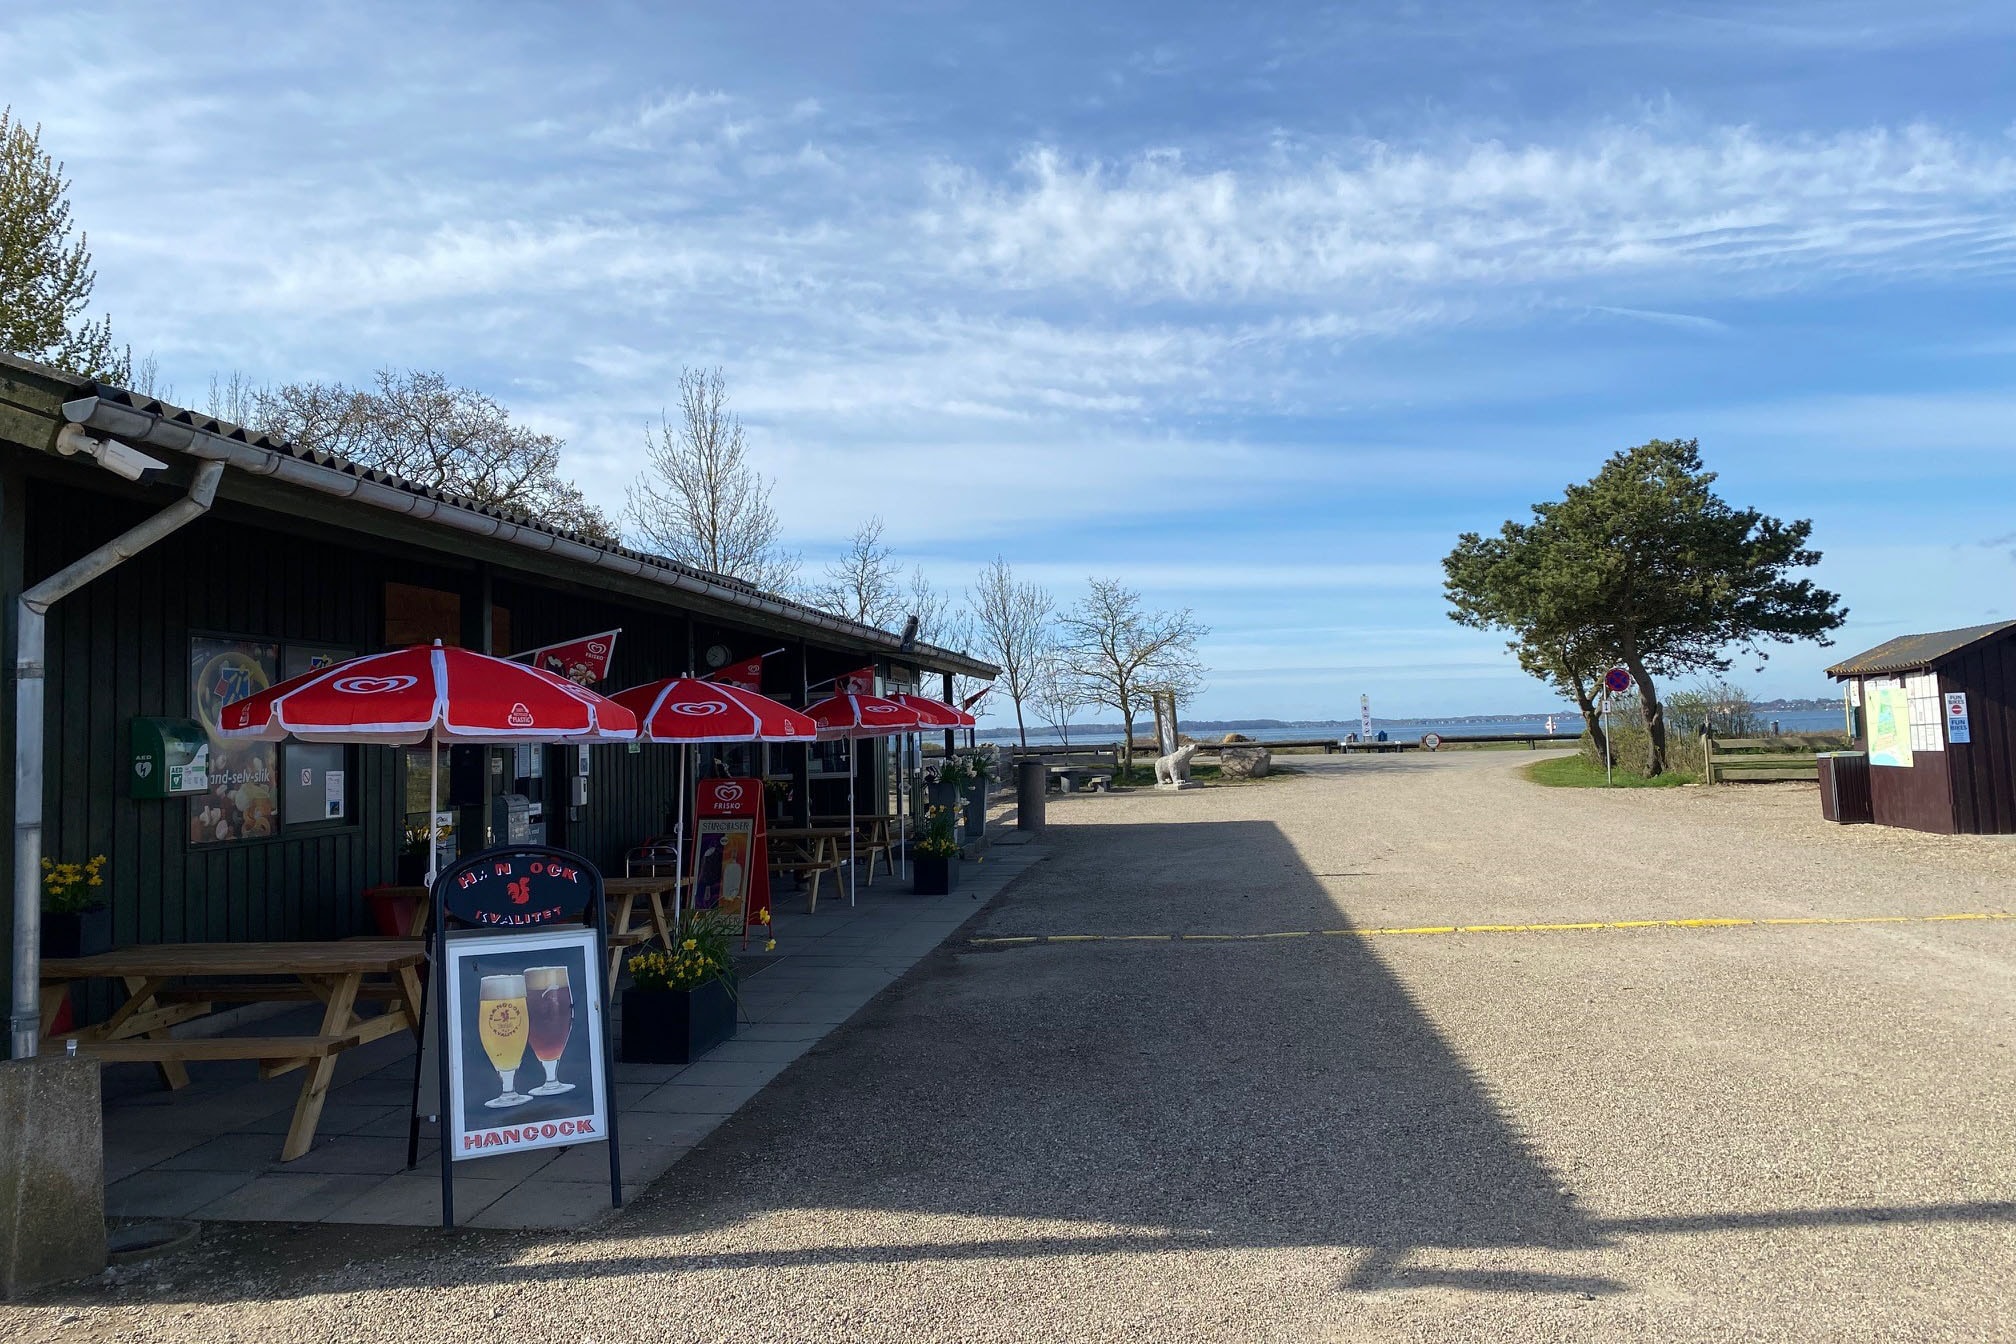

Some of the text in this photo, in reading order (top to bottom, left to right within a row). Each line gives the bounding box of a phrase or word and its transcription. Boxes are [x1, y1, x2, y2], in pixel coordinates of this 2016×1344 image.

[585, 652, 604, 660] FRISKO
[210, 769, 270, 785] and-selv-slik
[458, 862, 578, 889] HNOCK
[464, 1120, 596, 1150] HANCOCK
